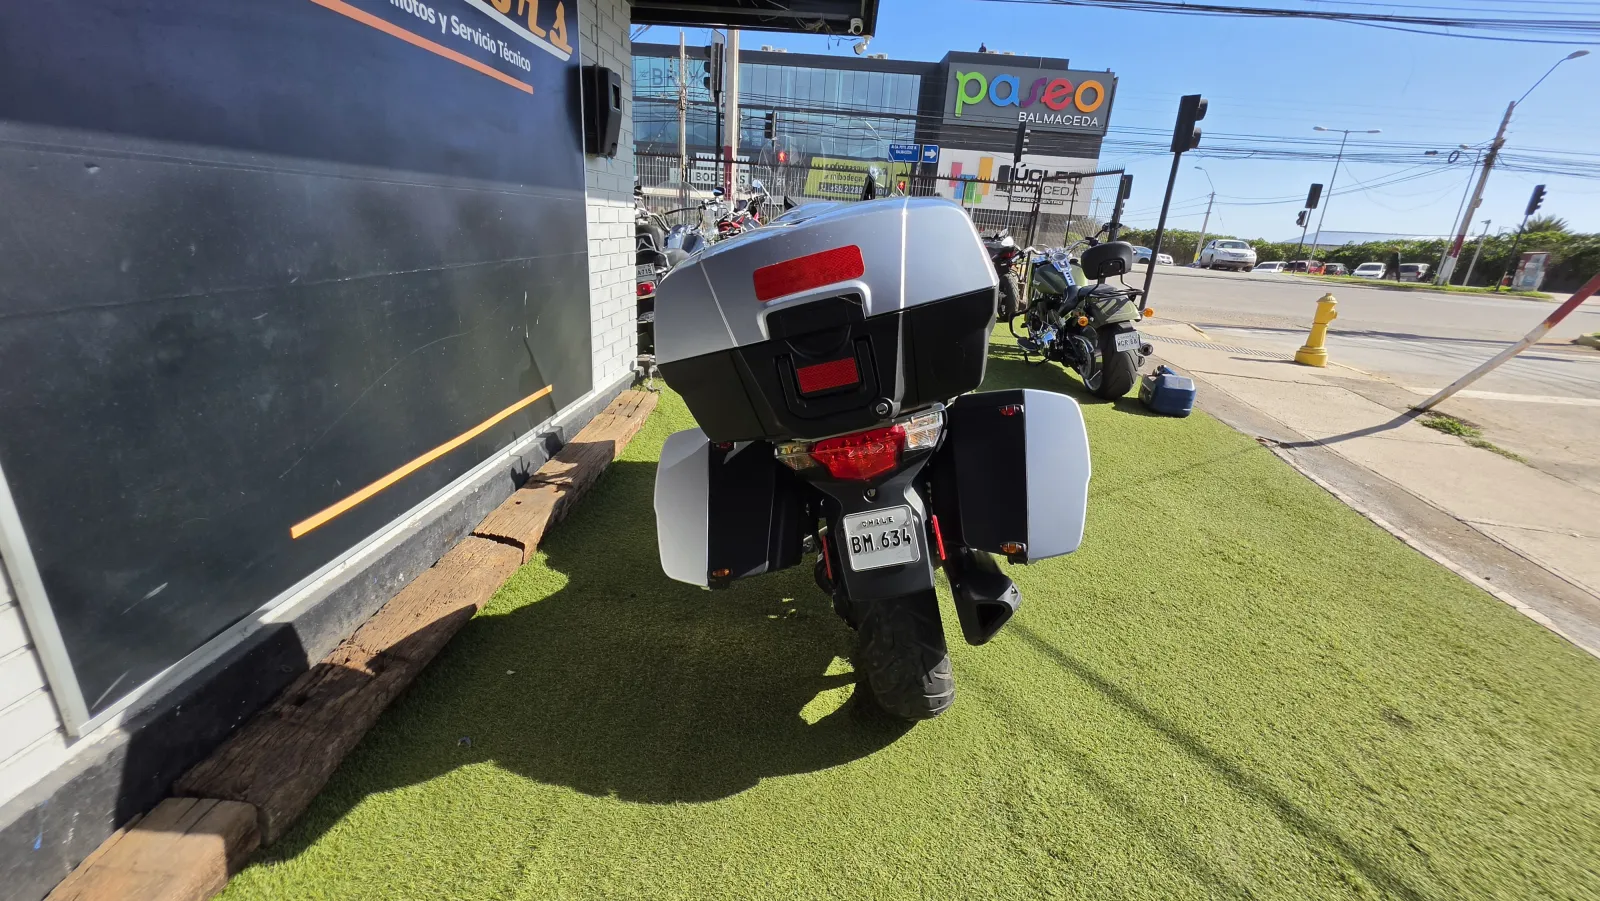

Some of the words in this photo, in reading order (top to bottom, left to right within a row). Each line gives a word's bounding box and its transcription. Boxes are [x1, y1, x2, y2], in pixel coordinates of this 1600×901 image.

[438, 12, 448, 34] y
[450, 15, 497, 54] Servicio
[497, 39, 531, 72] Técnico
[956, 71, 1105, 118] paseo
[1018, 111, 1099, 127] BALMACEDA
[861, 516, 894, 527] CHILE
[851, 528, 912, 554] BM.634
